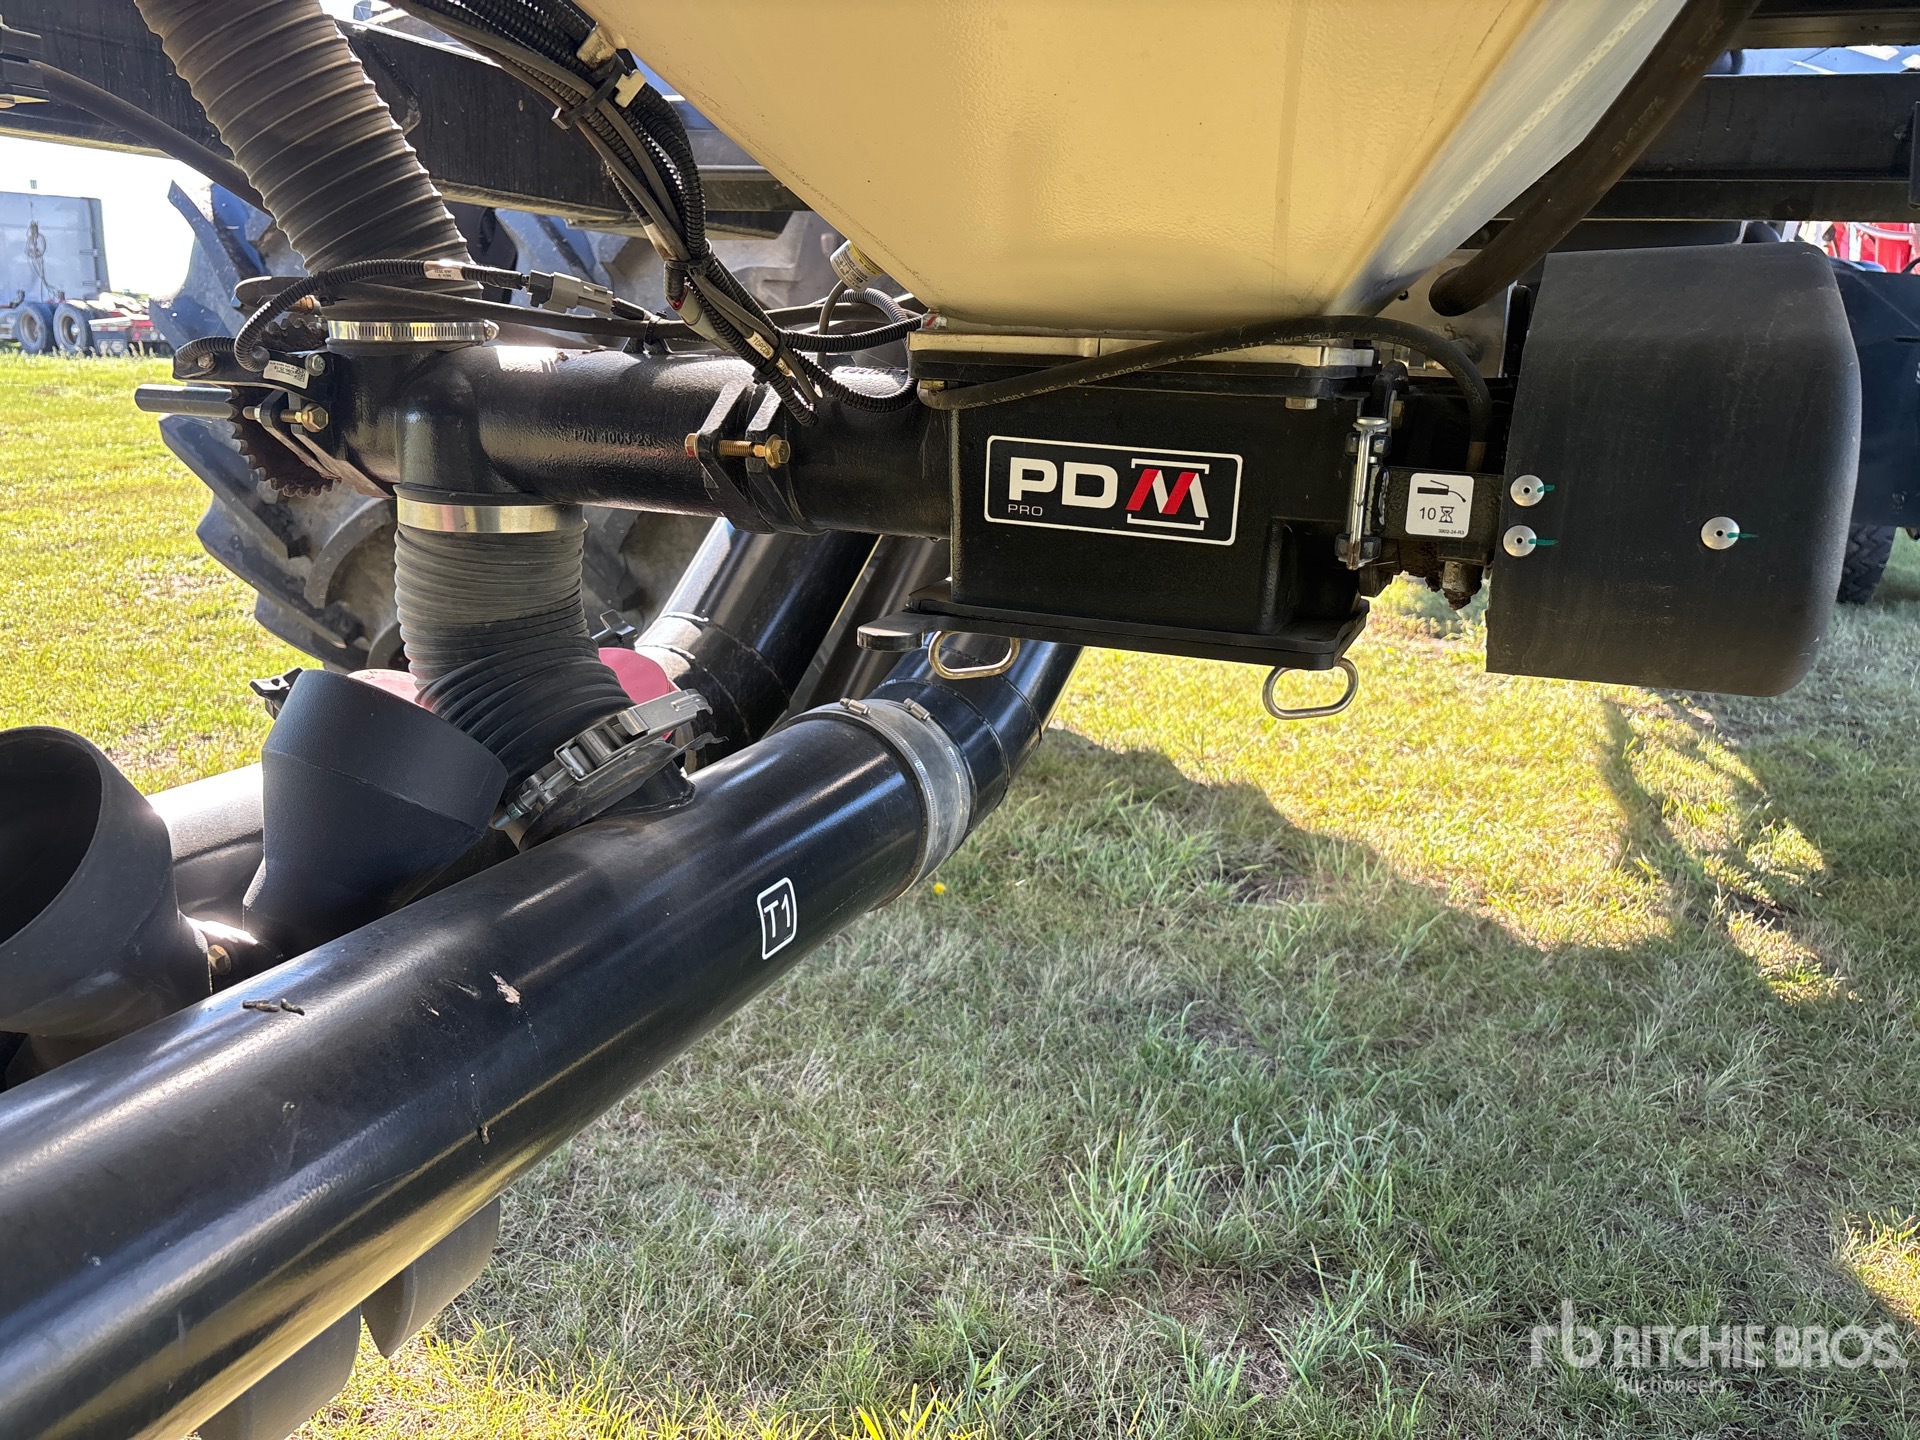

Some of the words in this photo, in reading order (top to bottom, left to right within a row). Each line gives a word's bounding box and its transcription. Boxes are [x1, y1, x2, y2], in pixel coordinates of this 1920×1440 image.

[752, 336, 772, 357] TOPCON
[1008, 456, 1210, 519] PDM
[1007, 503, 1043, 517] PRO
[1419, 506, 1437, 521] 10
[763, 893, 791, 939] T1
